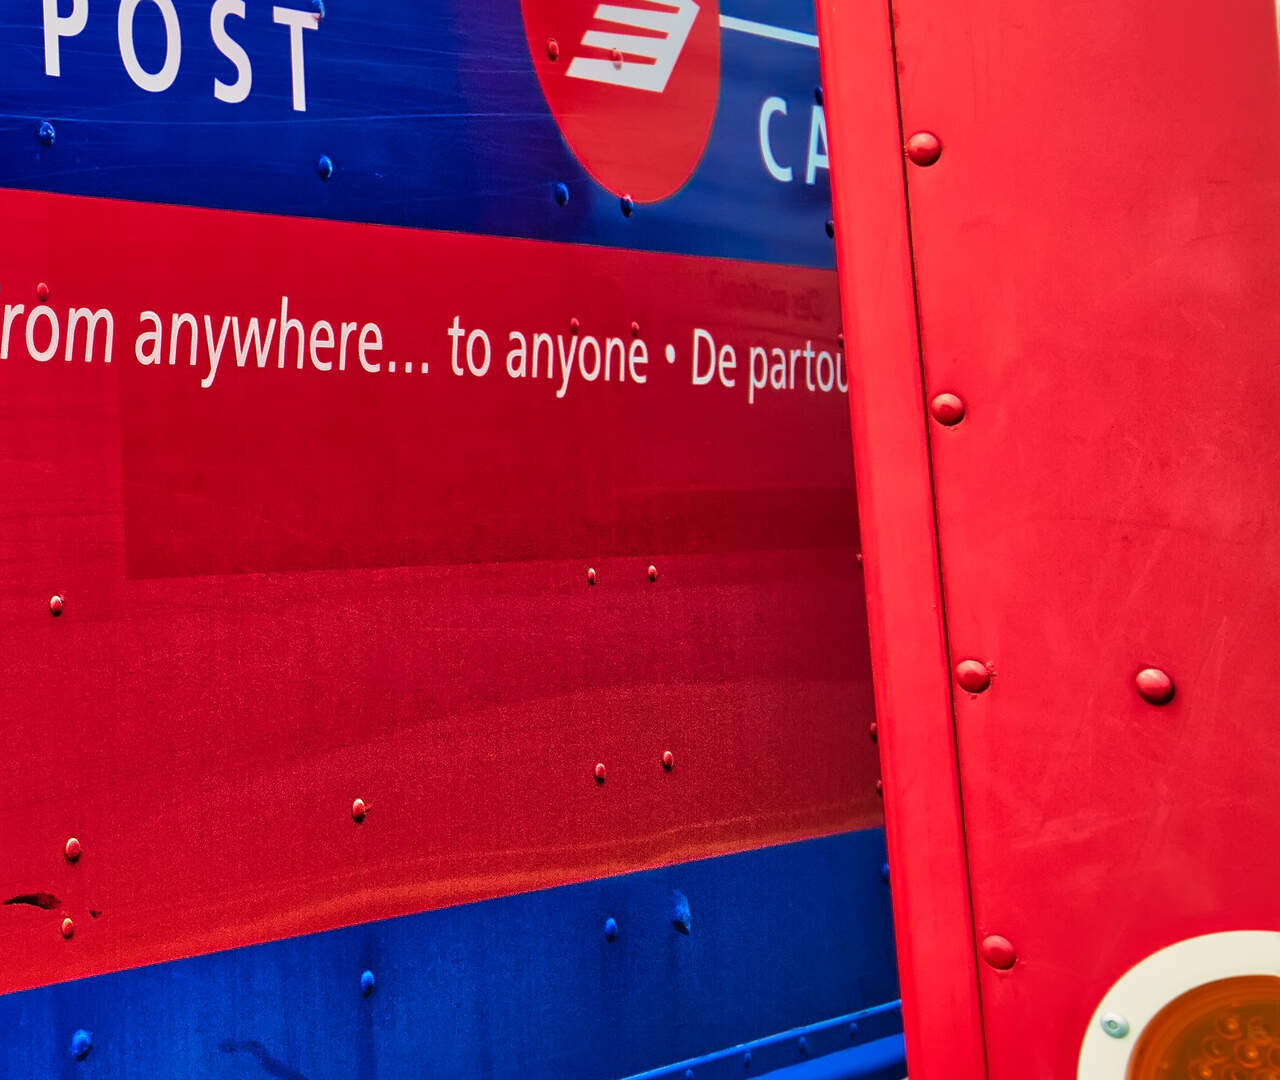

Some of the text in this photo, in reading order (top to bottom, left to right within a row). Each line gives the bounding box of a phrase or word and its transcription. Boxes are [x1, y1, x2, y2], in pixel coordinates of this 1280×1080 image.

[135, 295, 429, 389] anywhere...
[447, 315, 491, 377] to
[506, 329, 649, 399] anyone
[692, 328, 737, 388] De
